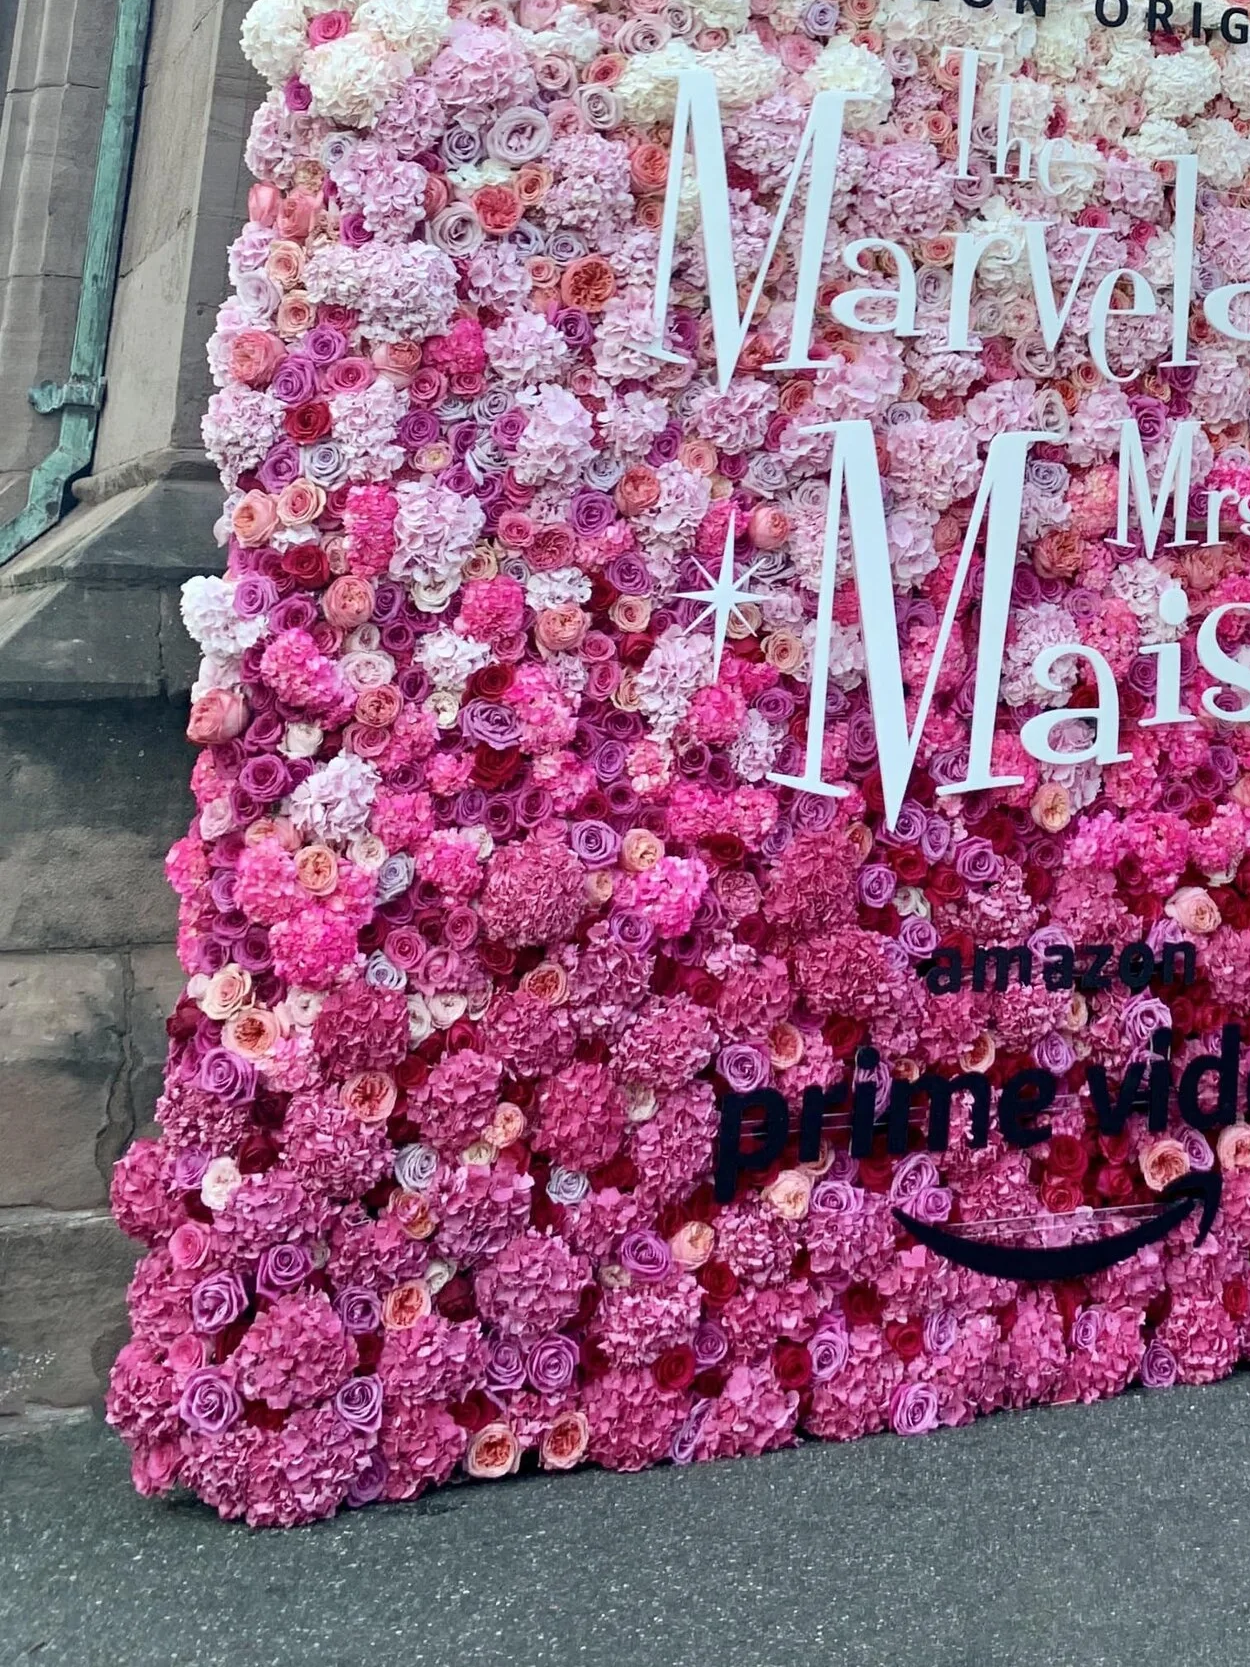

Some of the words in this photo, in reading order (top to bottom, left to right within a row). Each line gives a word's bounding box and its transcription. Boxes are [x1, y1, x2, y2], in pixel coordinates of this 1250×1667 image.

[939, 45, 1077, 196] The
[925, 940, 1197, 994] amazon
[715, 1047, 1054, 1204] prime
